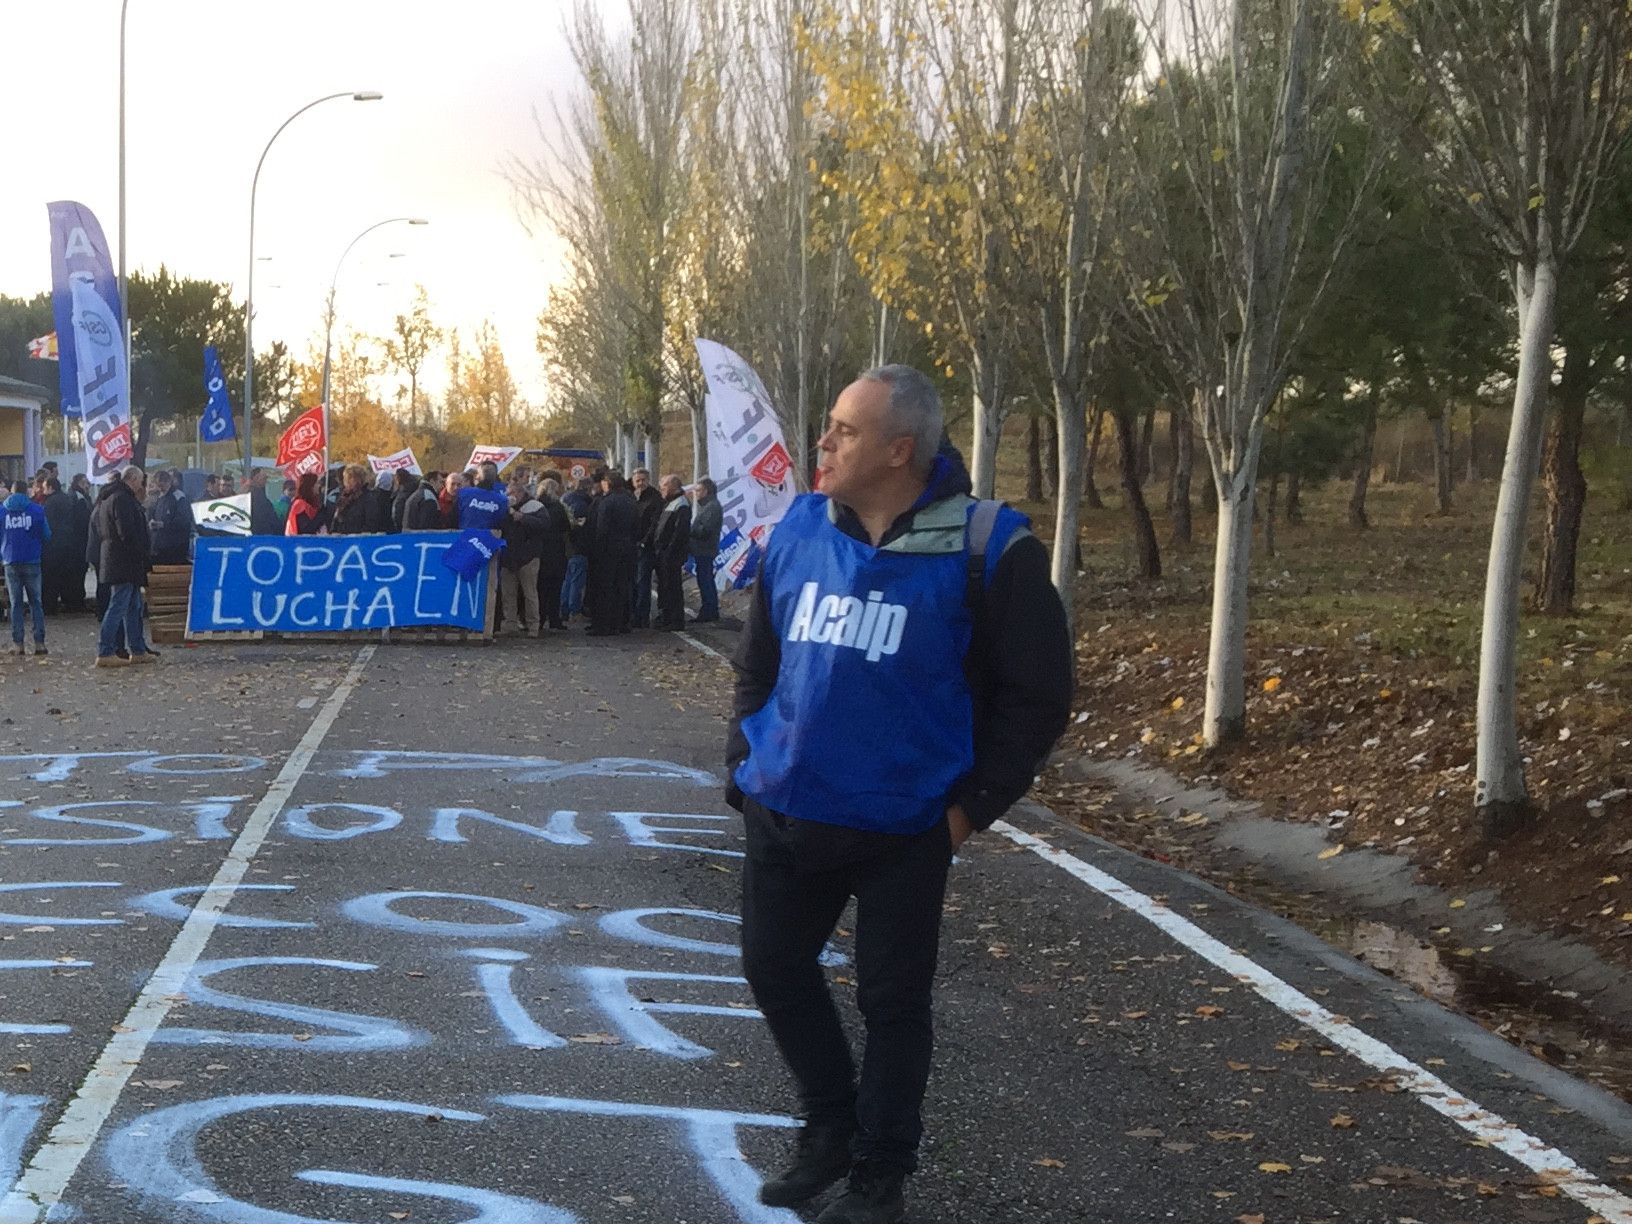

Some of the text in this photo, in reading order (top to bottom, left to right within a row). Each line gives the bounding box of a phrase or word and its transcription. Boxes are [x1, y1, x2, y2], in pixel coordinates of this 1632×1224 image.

[5, 513, 32, 530] Acaip
[469, 498, 500, 513] Acaip
[208, 544, 405, 588] TOPAS
[211, 586, 396, 629] LUCHA
[787, 582, 909, 662] Acaip
